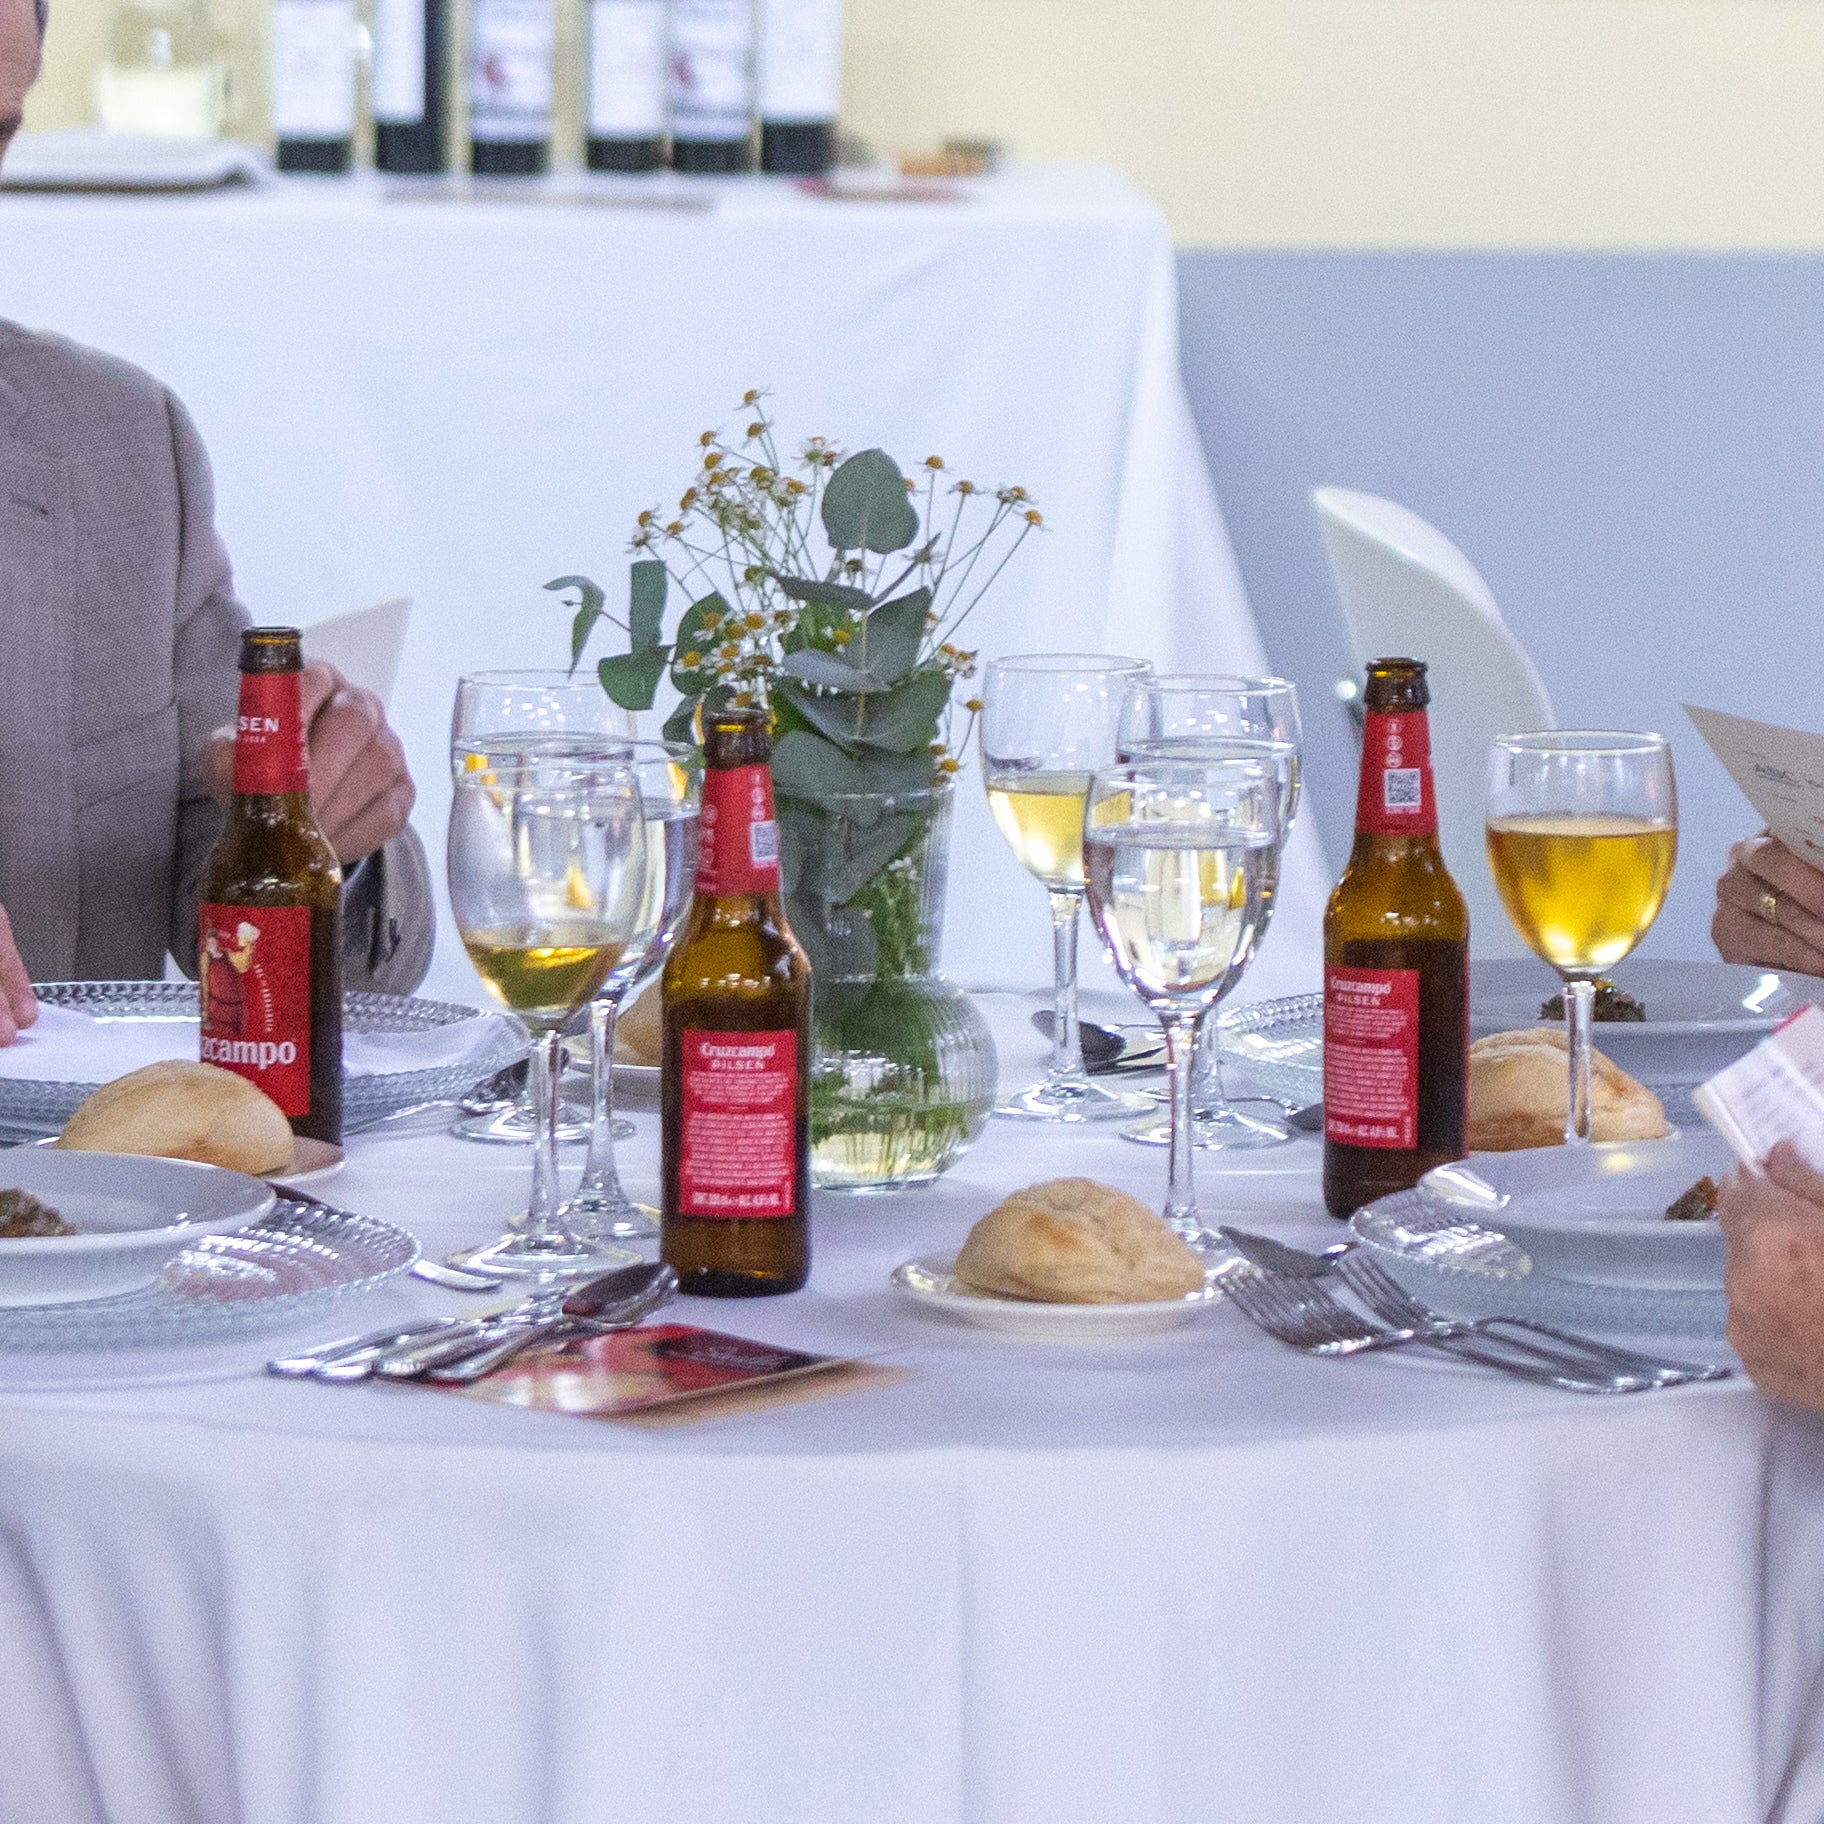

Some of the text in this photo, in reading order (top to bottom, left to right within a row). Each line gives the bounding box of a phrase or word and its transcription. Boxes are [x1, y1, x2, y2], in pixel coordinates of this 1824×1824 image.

[238, 715, 280, 734] SEN
[1331, 977, 1391, 995] Cruzcampo
[202, 1037, 296, 1069] zcampo
[700, 1042, 776, 1058] Cruzcampo
[711, 1060, 766, 1071] PILSEN
